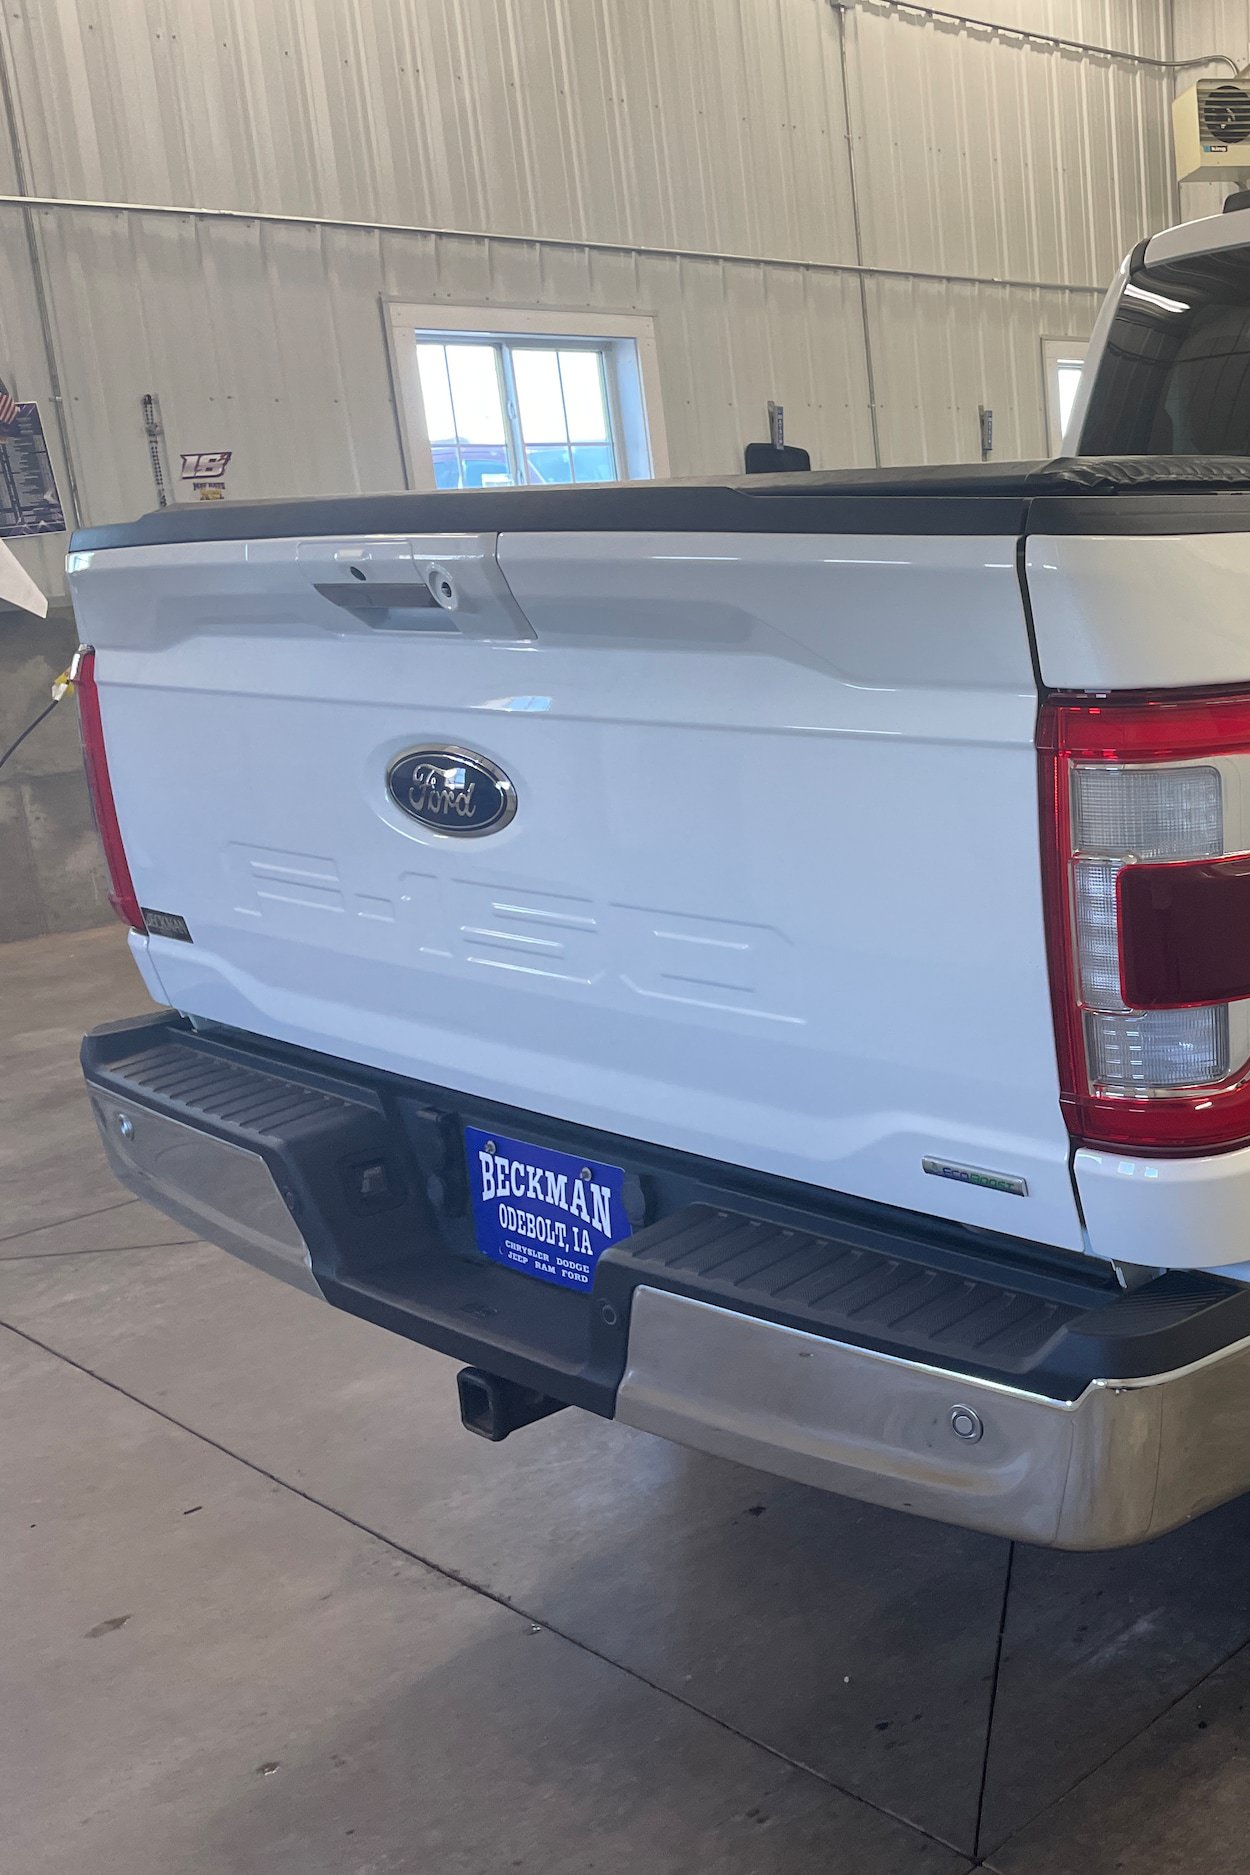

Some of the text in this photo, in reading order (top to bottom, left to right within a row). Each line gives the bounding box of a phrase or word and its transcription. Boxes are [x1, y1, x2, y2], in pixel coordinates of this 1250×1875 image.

[408, 763, 476, 818] Ford
[219, 840, 807, 1025] F-150
[479, 1150, 612, 1239] BECKMAN
[499, 1203, 594, 1256] ODEBOLT, IA
[505, 1239, 590, 1274] CHRYSLER DODGE
[507, 1252, 589, 1284] JEEP RAM FORD
